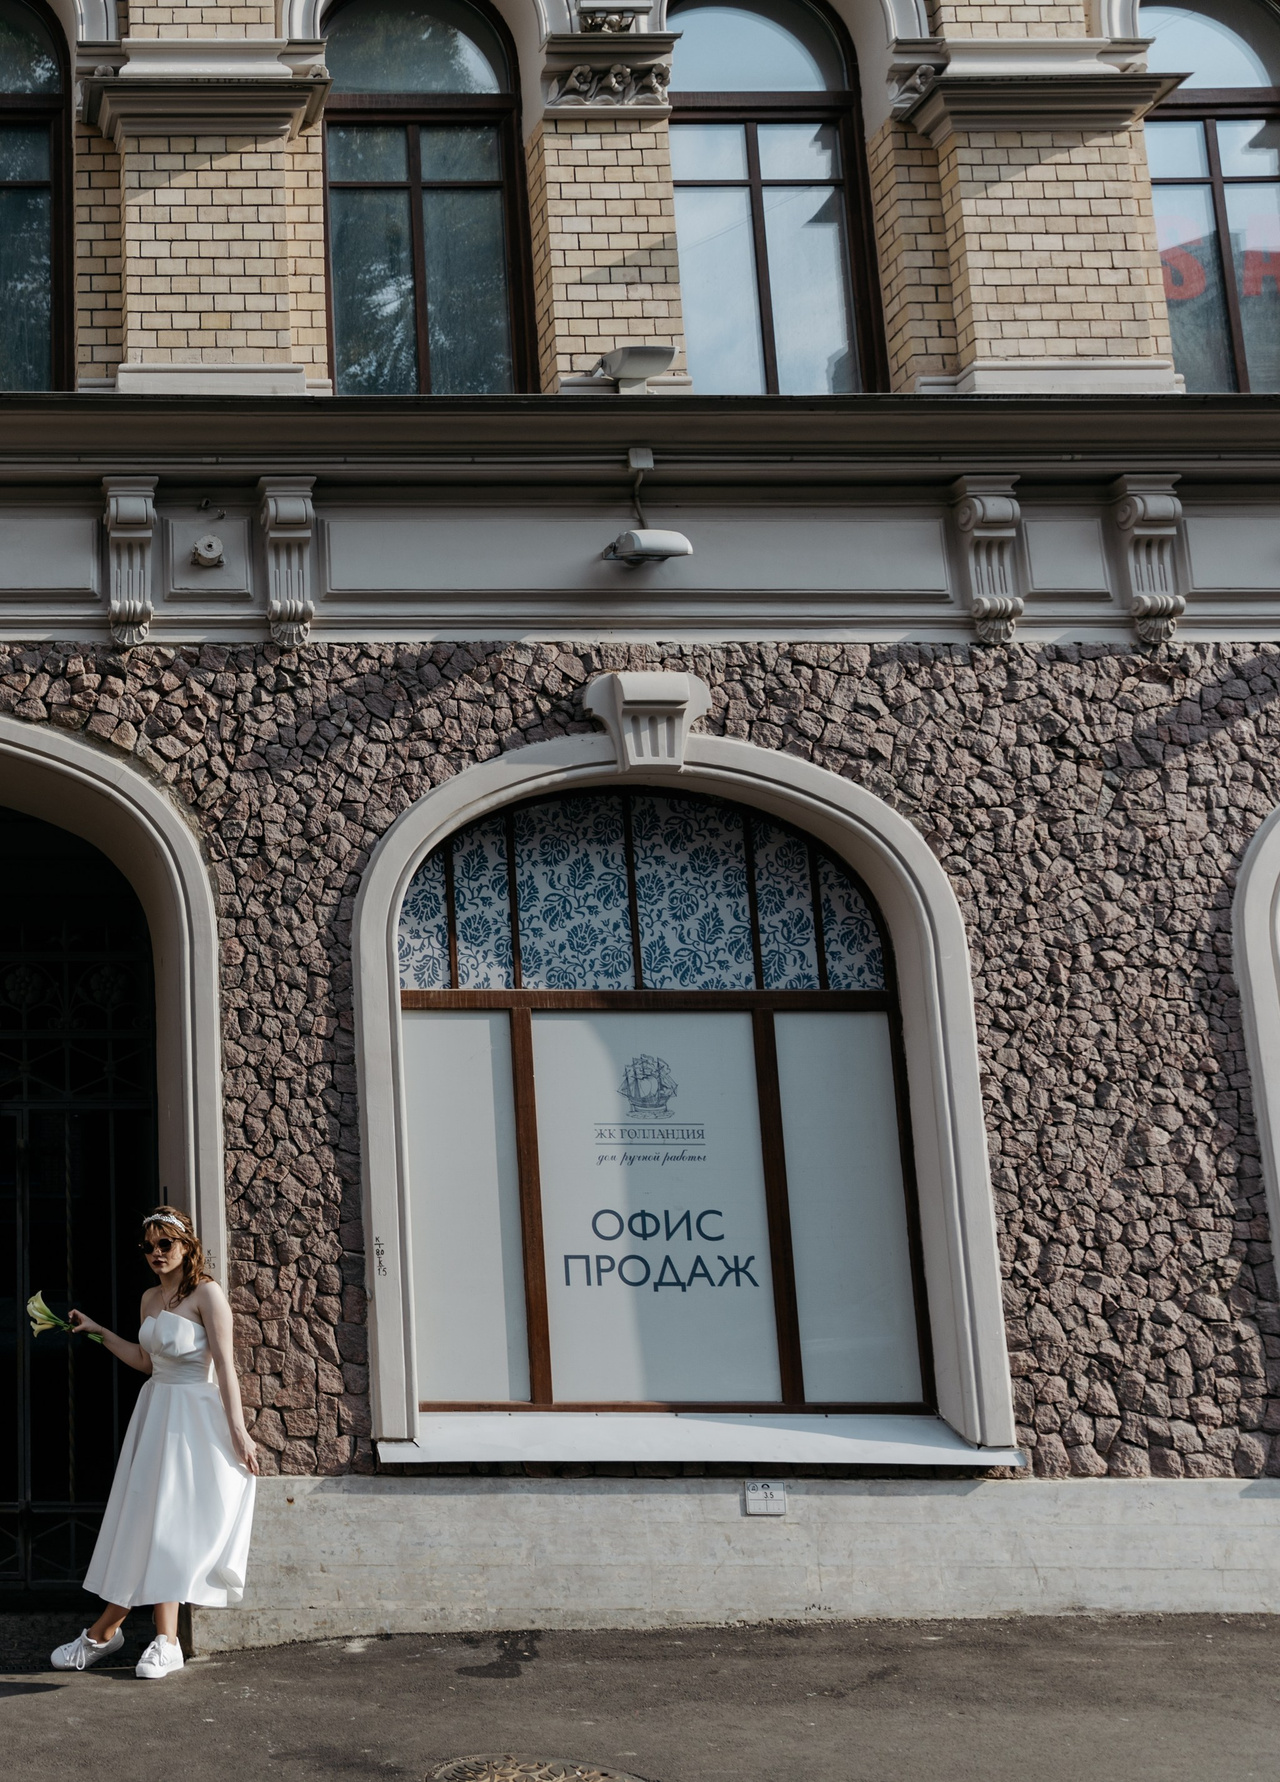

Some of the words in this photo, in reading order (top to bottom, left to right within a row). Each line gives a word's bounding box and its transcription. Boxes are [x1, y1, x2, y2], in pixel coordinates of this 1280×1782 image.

[594, 1128, 616, 1139] ЖК
[620, 1128, 705, 1140] ГОЛЛАНДИЯ
[596, 1154, 618, 1166] дом
[620, 1151, 661, 1166] ручной
[662, 1149, 707, 1166] работы
[591, 1209, 725, 1241] ОФИС
[563, 1254, 760, 1292] ПРОДАЖ
